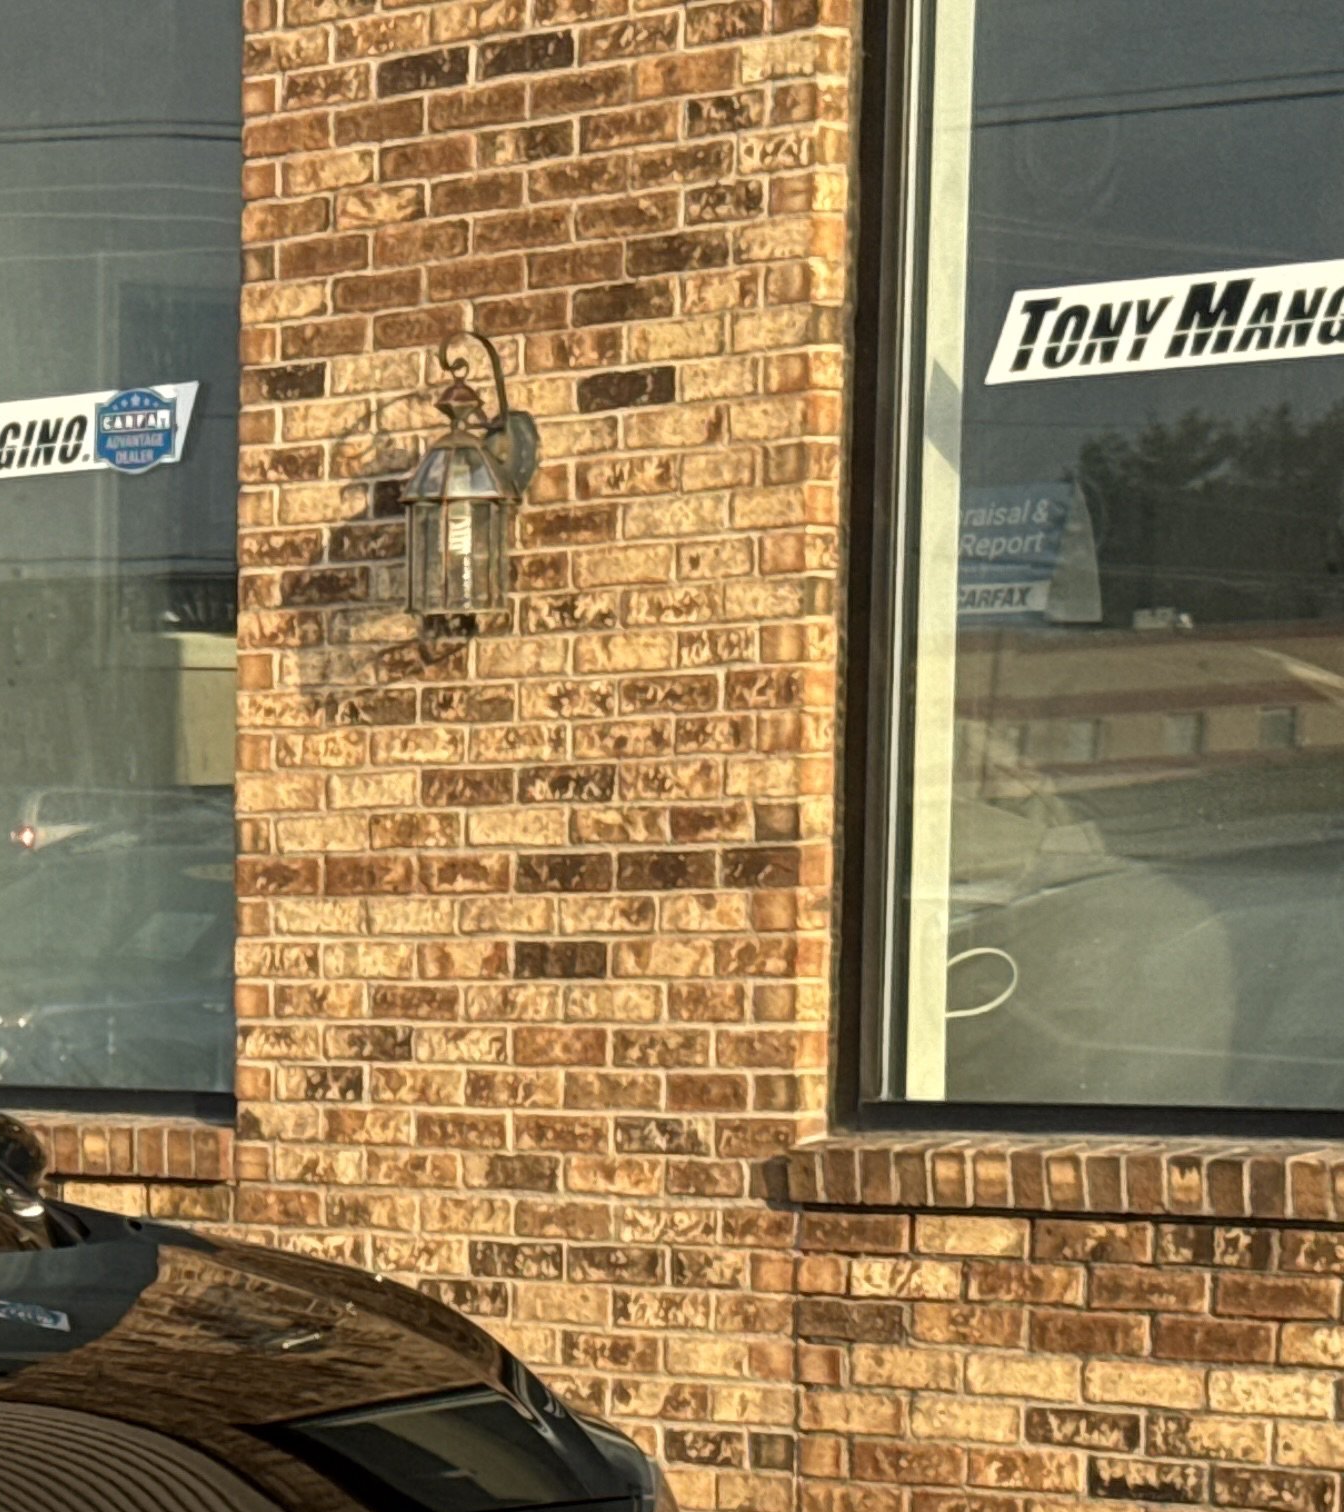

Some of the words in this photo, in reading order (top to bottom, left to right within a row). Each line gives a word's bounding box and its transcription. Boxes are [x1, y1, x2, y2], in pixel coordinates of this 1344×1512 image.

[1009, 296, 1174, 372] TONY
[958, 499, 1031, 527] raisal
[1033, 498, 1050, 525] &
[958, 532, 1046, 560] Report
